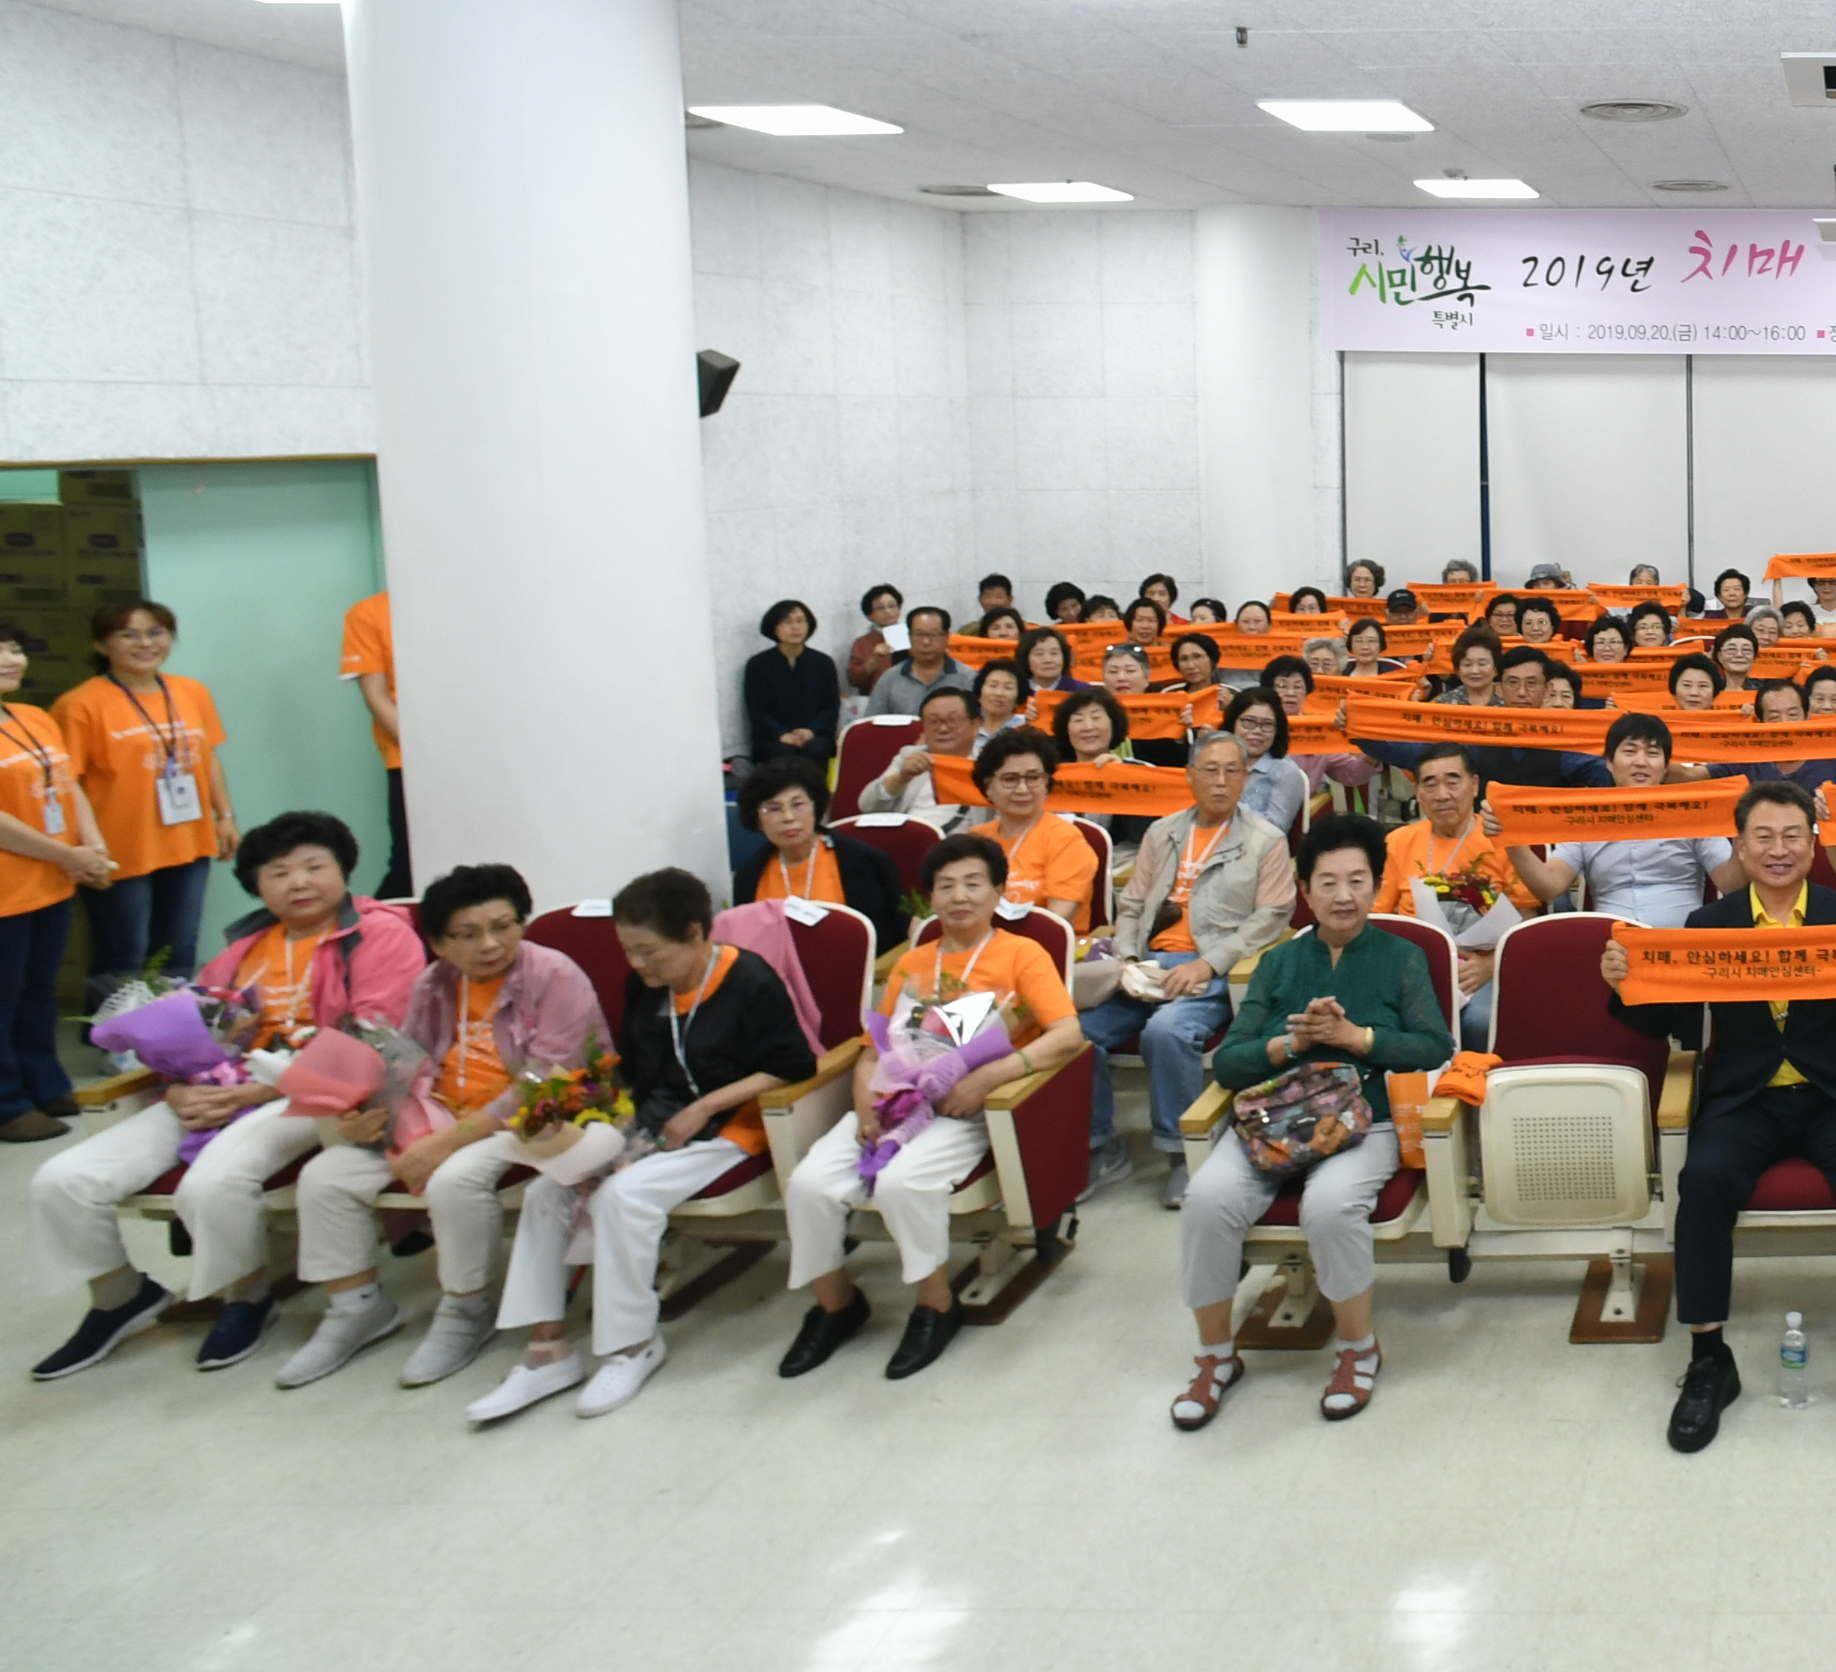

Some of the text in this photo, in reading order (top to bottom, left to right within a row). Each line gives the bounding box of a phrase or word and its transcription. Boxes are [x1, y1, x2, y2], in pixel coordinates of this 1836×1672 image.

[1521, 254, 1654, 293] 2019년
[1680, 229, 1806, 284] 치매
[1349, 244, 1492, 307] 시민행복
[1432, 310, 1473, 330] 특별시
[1540, 323, 1569, 341] 일시
[1587, 323, 1697, 343] 2019.09.20.(금)
[1704, 325, 1806, 341] 14:00~16:00
[1686, 950, 1771, 966] 안심하세요!
[1777, 949, 1809, 963] 함께
